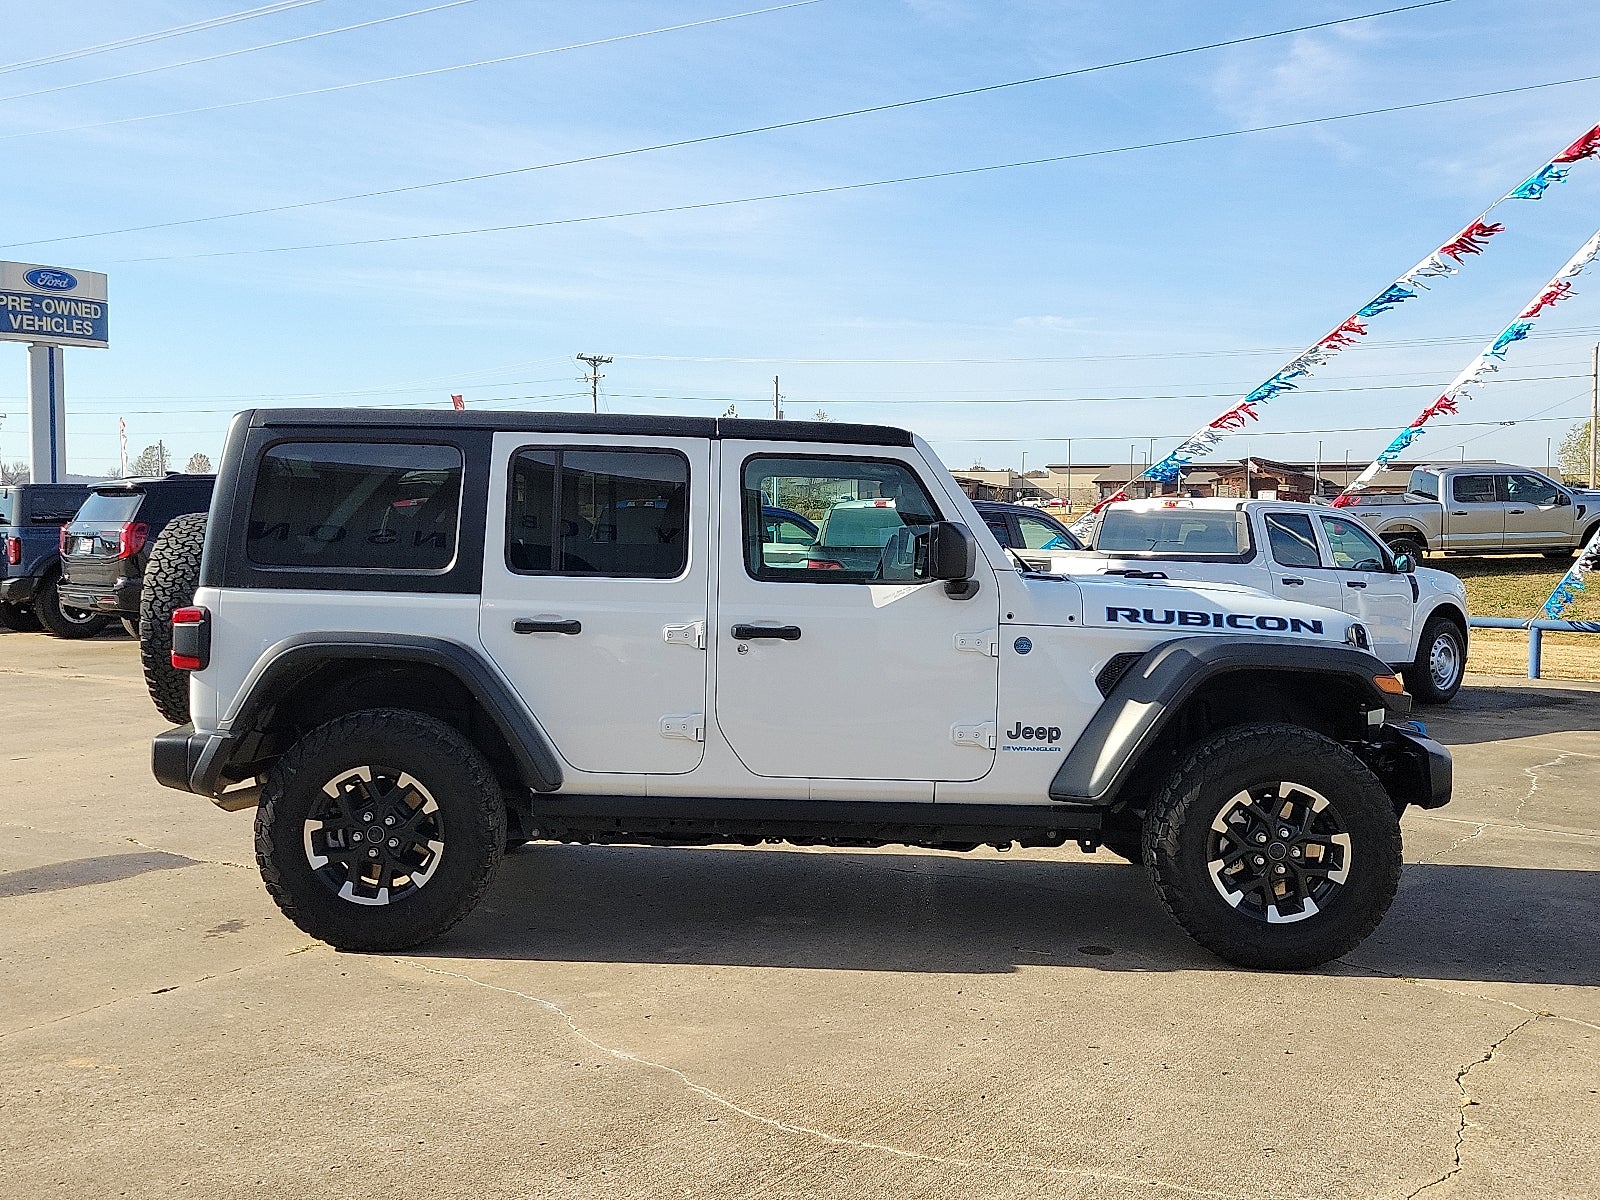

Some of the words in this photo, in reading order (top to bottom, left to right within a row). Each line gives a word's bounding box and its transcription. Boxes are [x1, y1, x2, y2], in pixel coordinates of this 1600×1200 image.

[37, 271, 69, 288] Ford
[9, 313, 94, 336] VEHICLES
[1106, 606, 1324, 634] RUBICON
[1007, 721, 1062, 744] Jeep
